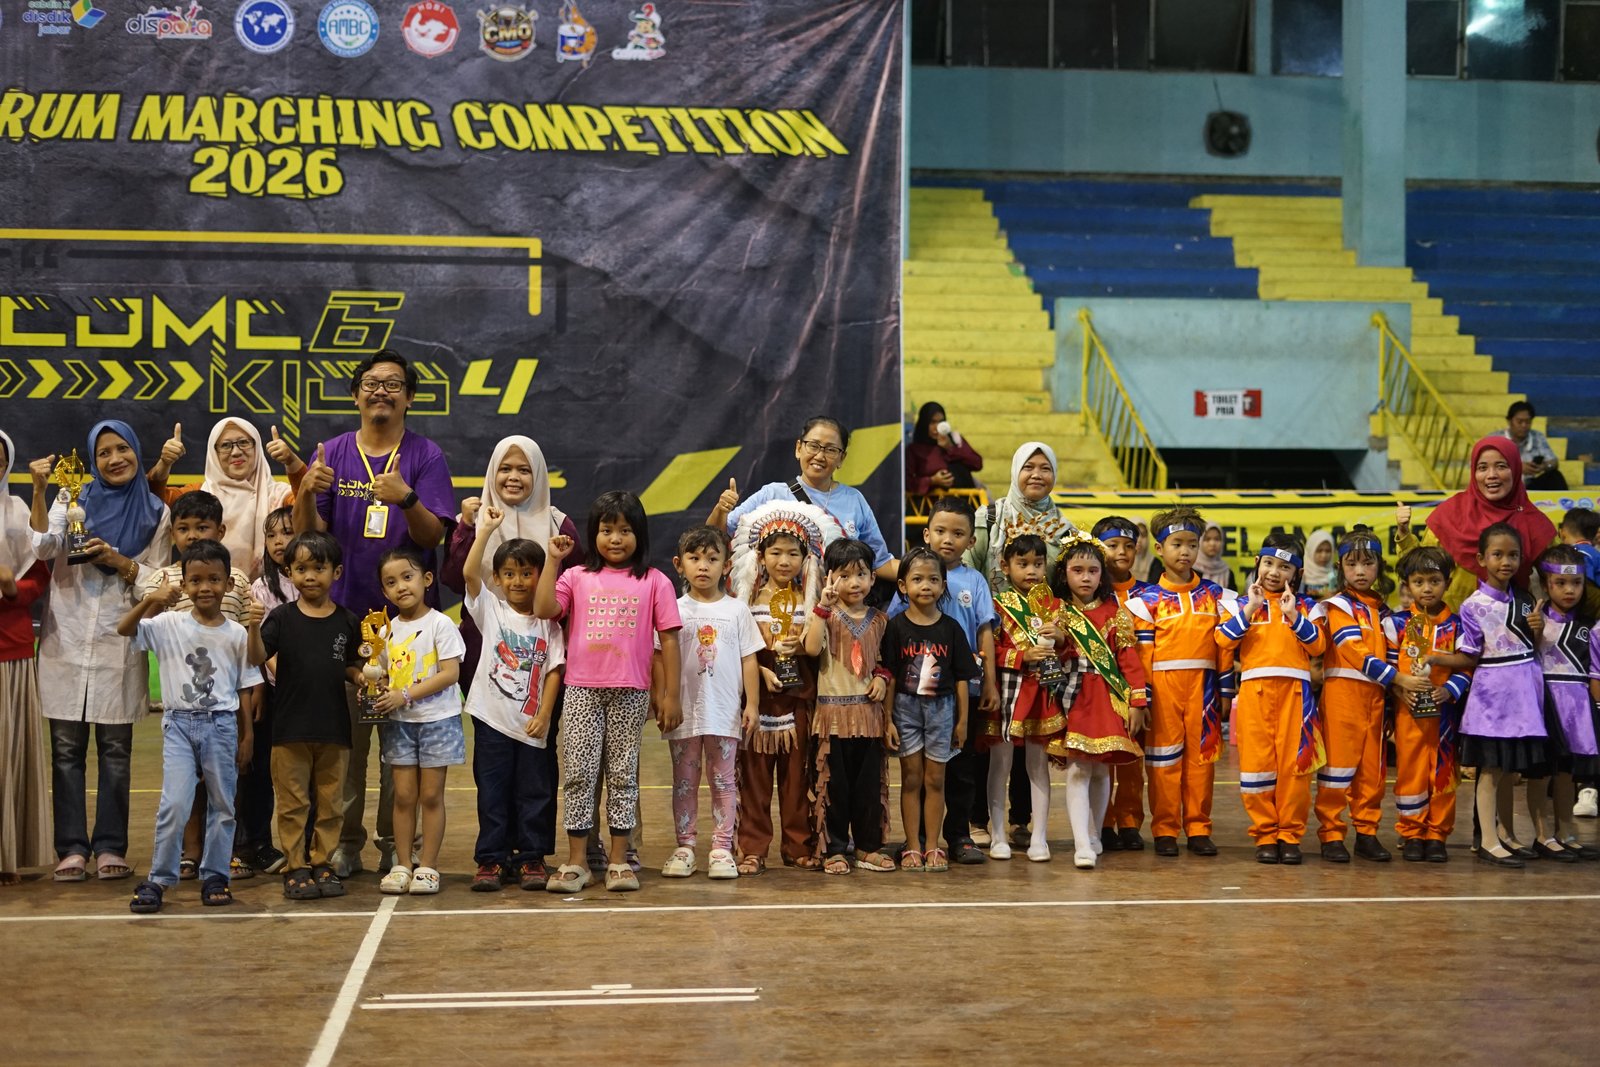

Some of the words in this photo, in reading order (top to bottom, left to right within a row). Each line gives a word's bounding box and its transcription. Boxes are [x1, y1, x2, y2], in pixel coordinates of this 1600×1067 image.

[22, 10, 71, 24] disdik
[326, 18, 370, 36] AMBC
[484, 23, 531, 43] CMO
[131, 93, 442, 151] MARCHING
[451, 102, 850, 158] COMPETITION
[189, 144, 344, 199] 2026
[308, 290, 405, 353] 6
[458, 358, 539, 414] 4
[1212, 395, 1238, 405] TOILET
[901, 639, 948, 658] MULAN
